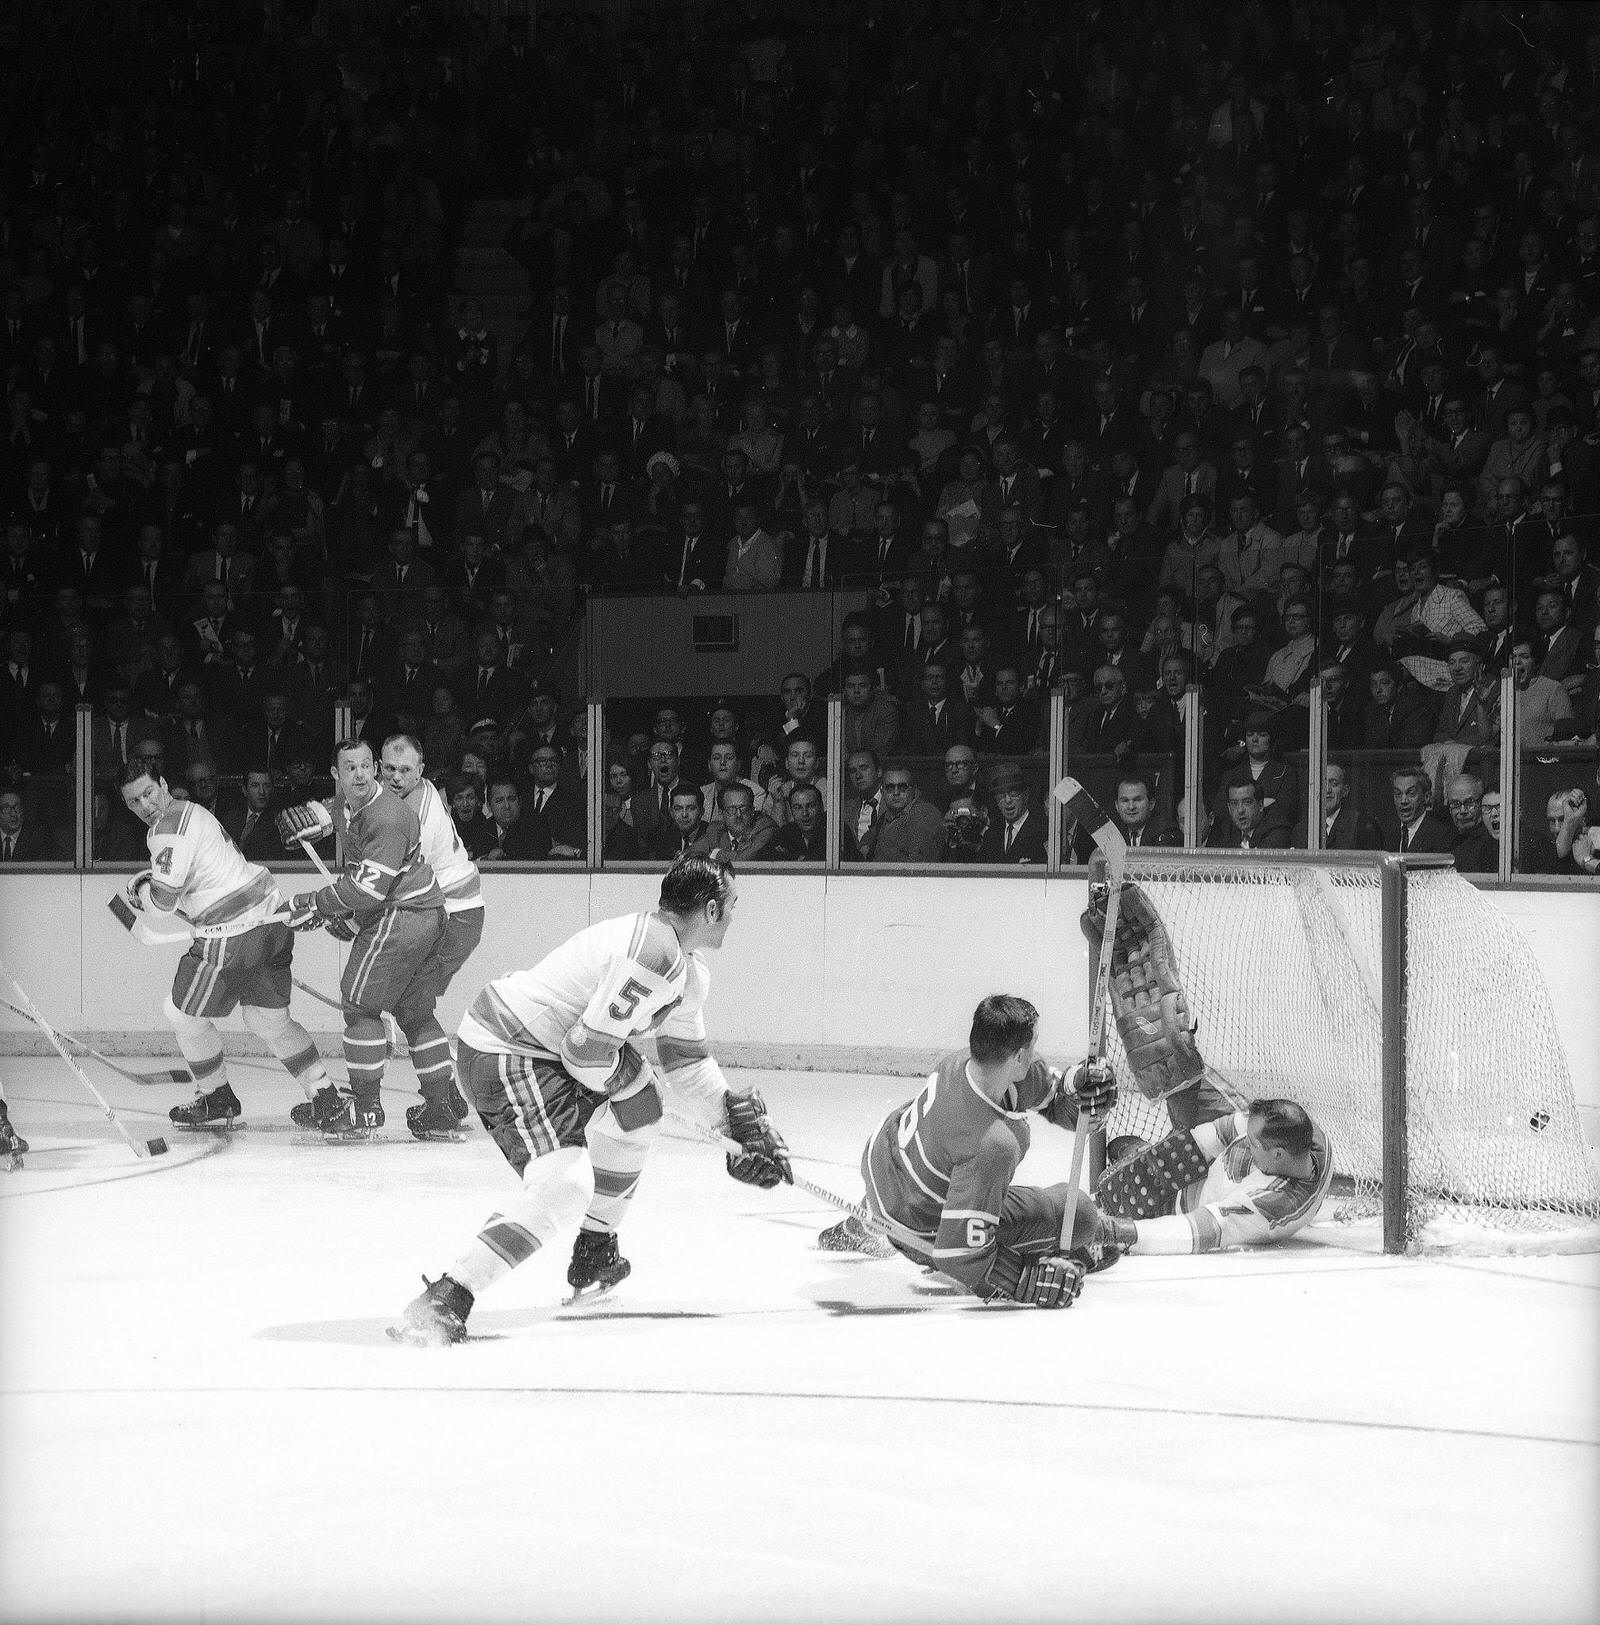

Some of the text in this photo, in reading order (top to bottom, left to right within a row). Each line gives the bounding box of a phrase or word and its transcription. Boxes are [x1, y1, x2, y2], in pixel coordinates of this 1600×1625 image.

[155, 846, 174, 876] 4
[355, 864, 381, 890] 12
[608, 976, 653, 1022] 5
[363, 1112, 378, 1127] 12
[898, 1071, 939, 1149] 6
[804, 1181, 869, 1219] NORTHLAND
[966, 1217, 986, 1248] 6
